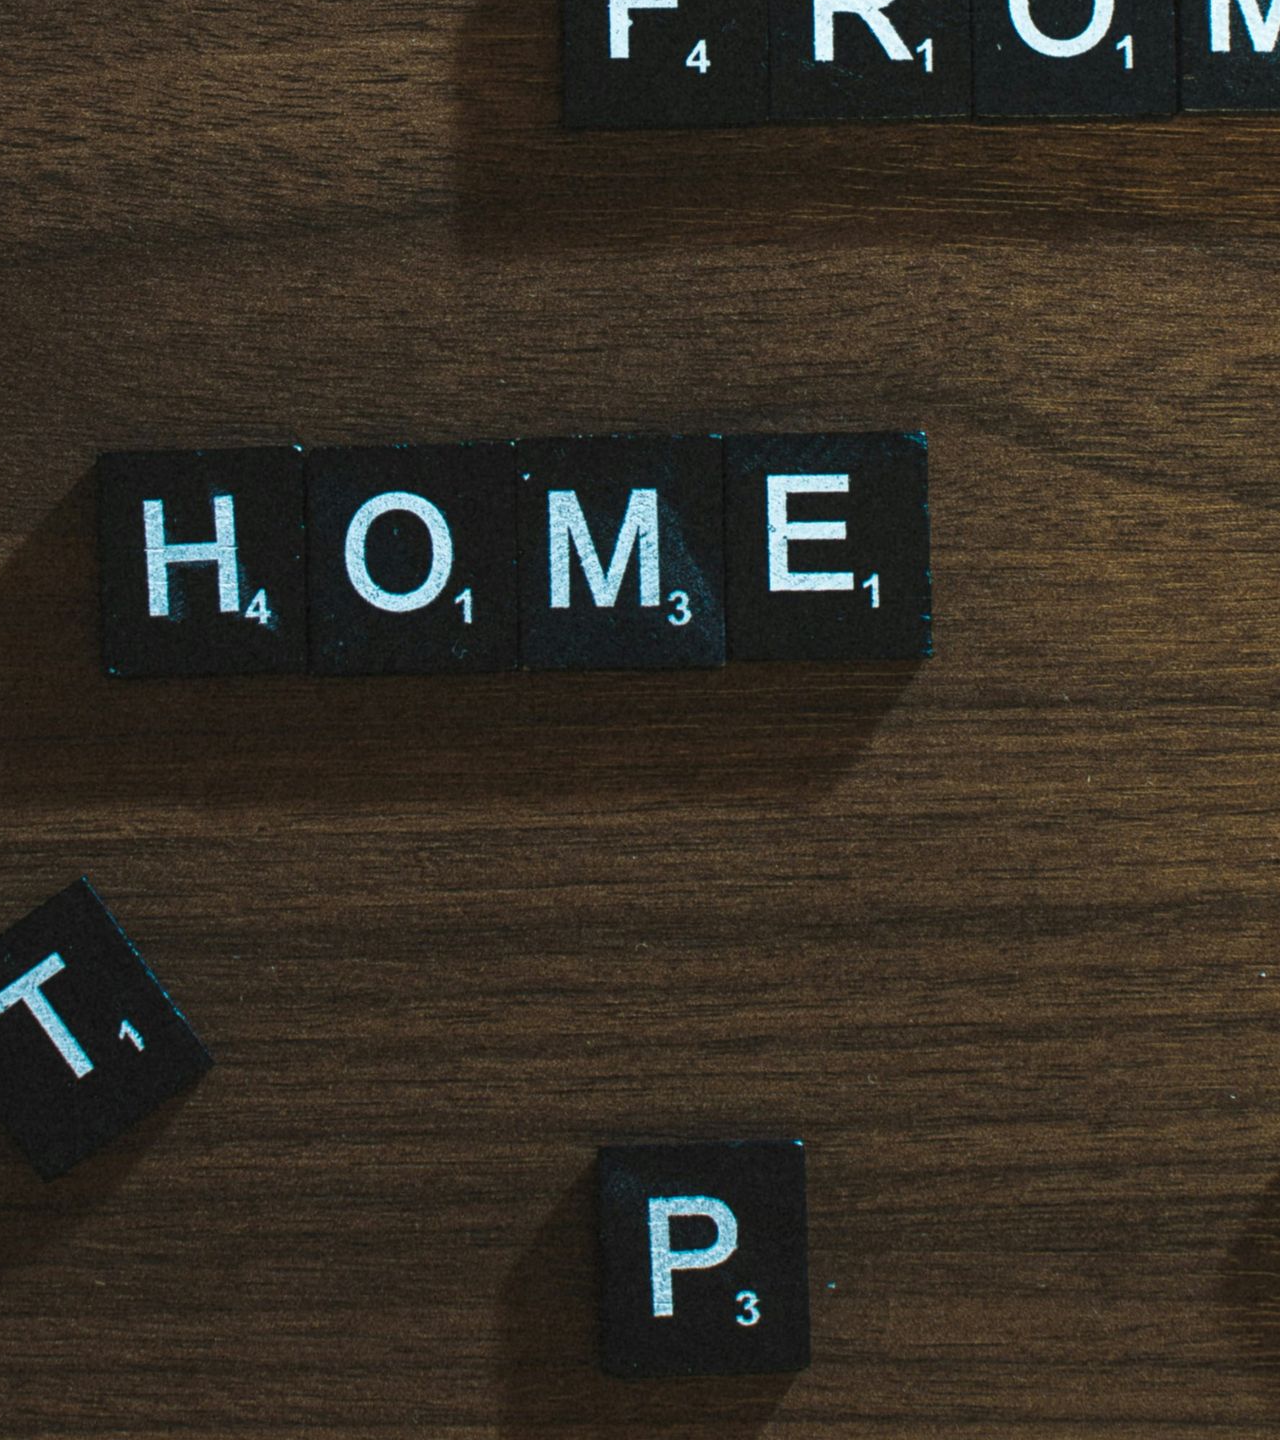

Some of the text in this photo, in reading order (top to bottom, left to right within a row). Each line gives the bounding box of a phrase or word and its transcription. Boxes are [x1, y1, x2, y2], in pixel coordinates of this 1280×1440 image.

[686, 40, 711, 73] 4
[917, 39, 933, 72] 1
[1117, 35, 1133, 69] 1
[143, 475, 854, 618] HOME
[245, 590, 271, 624] 4
[455, 590, 472, 624] 1
[863, 575, 879, 608] 1
[668, 592, 692, 626] 3
[119, 1022, 143, 1051] 1
[649, 1197, 737, 1317] P
[737, 1293, 760, 1326] 3
